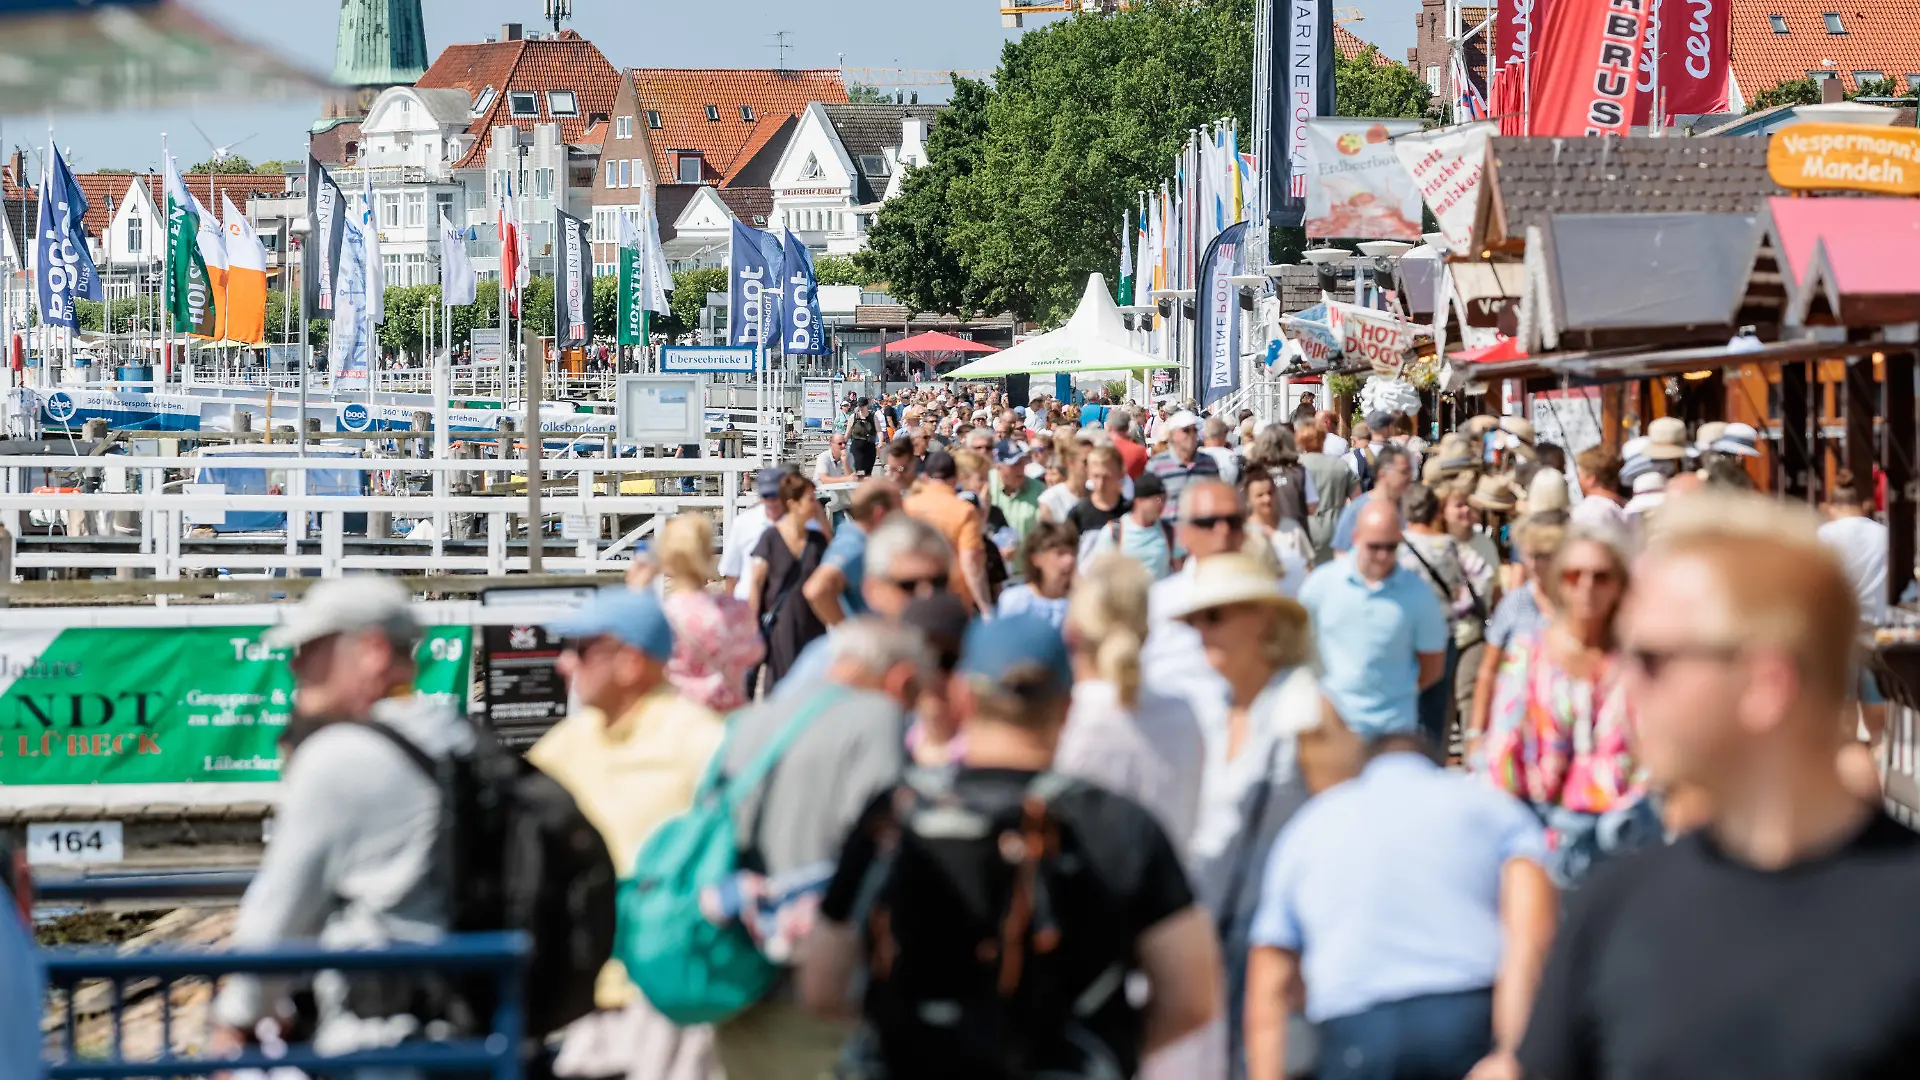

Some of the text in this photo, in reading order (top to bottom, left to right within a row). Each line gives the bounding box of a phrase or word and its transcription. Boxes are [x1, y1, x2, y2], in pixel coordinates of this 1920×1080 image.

[1294, 0, 1311, 154] ARINEPOOL
[1802, 155, 1903, 184] Mandeln
[739, 265, 764, 343] boot
[670, 353, 748, 364] Überseebrücke 1
[105, 398, 152, 408] Wassersport
[153, 400, 185, 410] erleben.
[345, 410, 366, 419] boot
[448, 413, 480, 423] erleben.
[48, 830, 103, 853] 164
